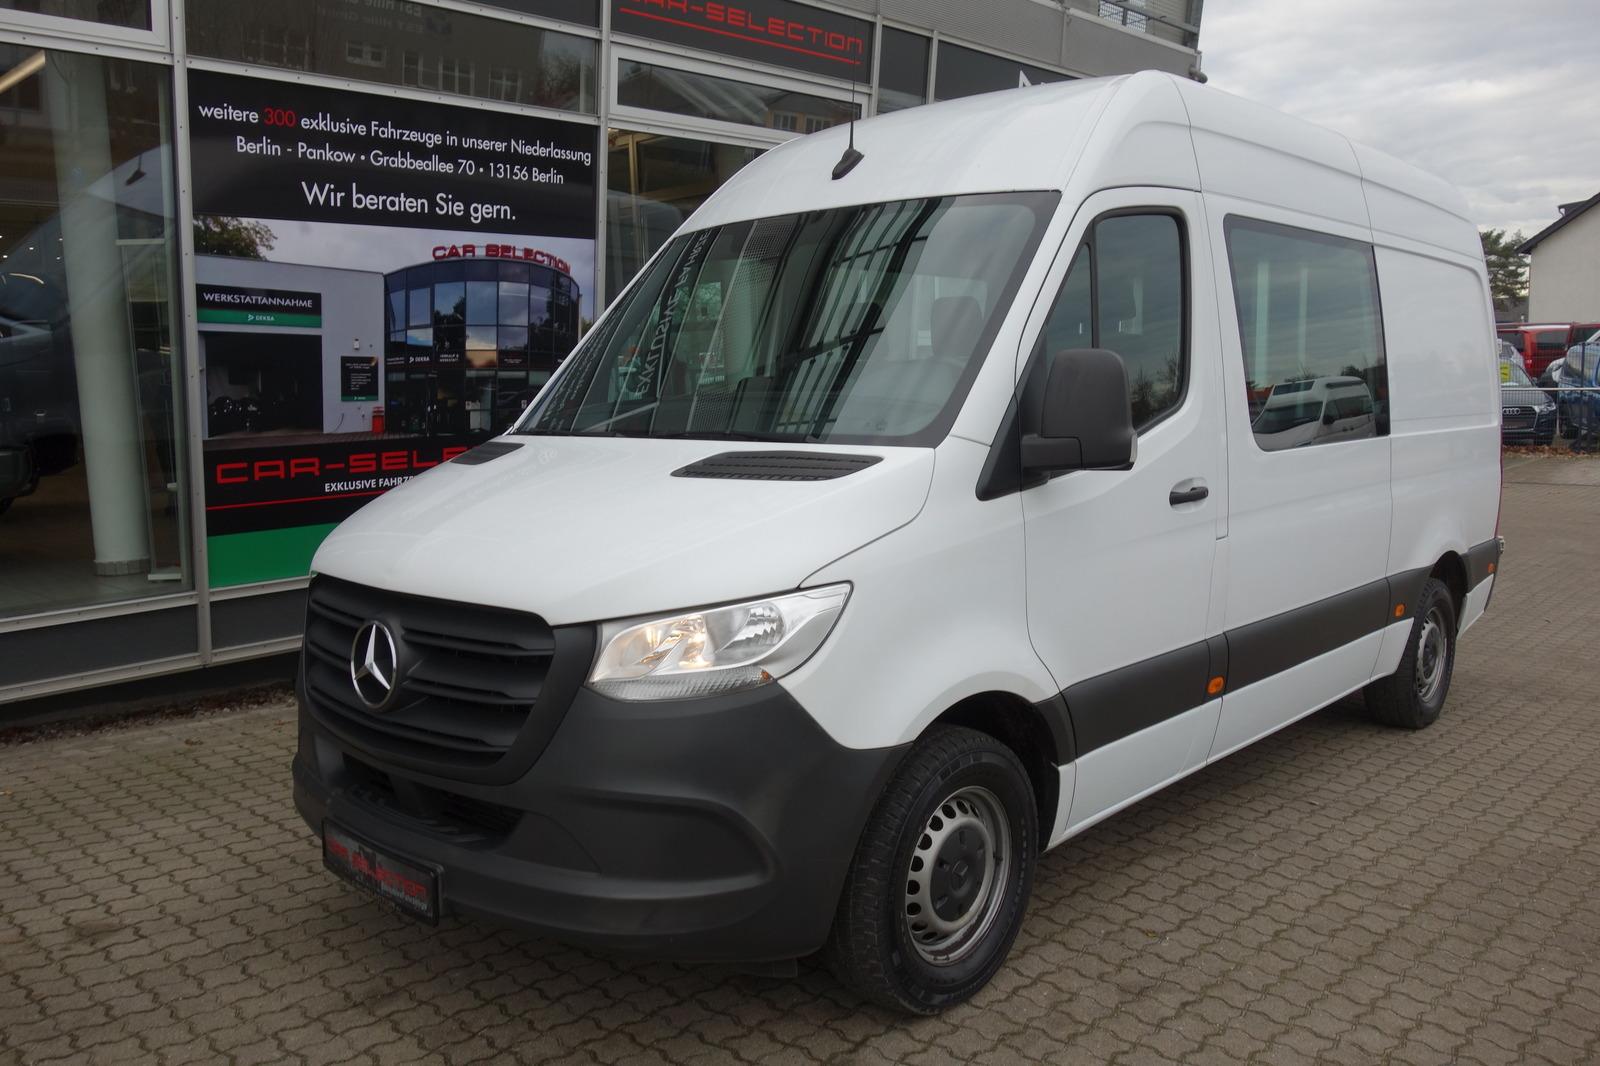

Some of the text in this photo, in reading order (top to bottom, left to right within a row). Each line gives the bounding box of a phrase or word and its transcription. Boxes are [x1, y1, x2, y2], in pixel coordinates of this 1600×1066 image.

[632, 0, 863, 54] R-SELECTION
[199, 104, 592, 166] weitere 300 exklusive Fahrzeuge in unserer Niederlassung
[236, 136, 281, 156] Berlin
[298, 142, 356, 163] Pankow
[370, 150, 454, 174] Grabbeallee
[458, 159, 476, 176] 70
[489, 163, 529, 181] 13156
[532, 168, 564, 184] Berlin
[301, 181, 516, 223] Wir beraten Sie gern.
[432, 244, 476, 260] CAR
[203, 292, 313, 308] WERKSTATTANNAHME
[324, 478, 377, 493] EXKLUSIVE
